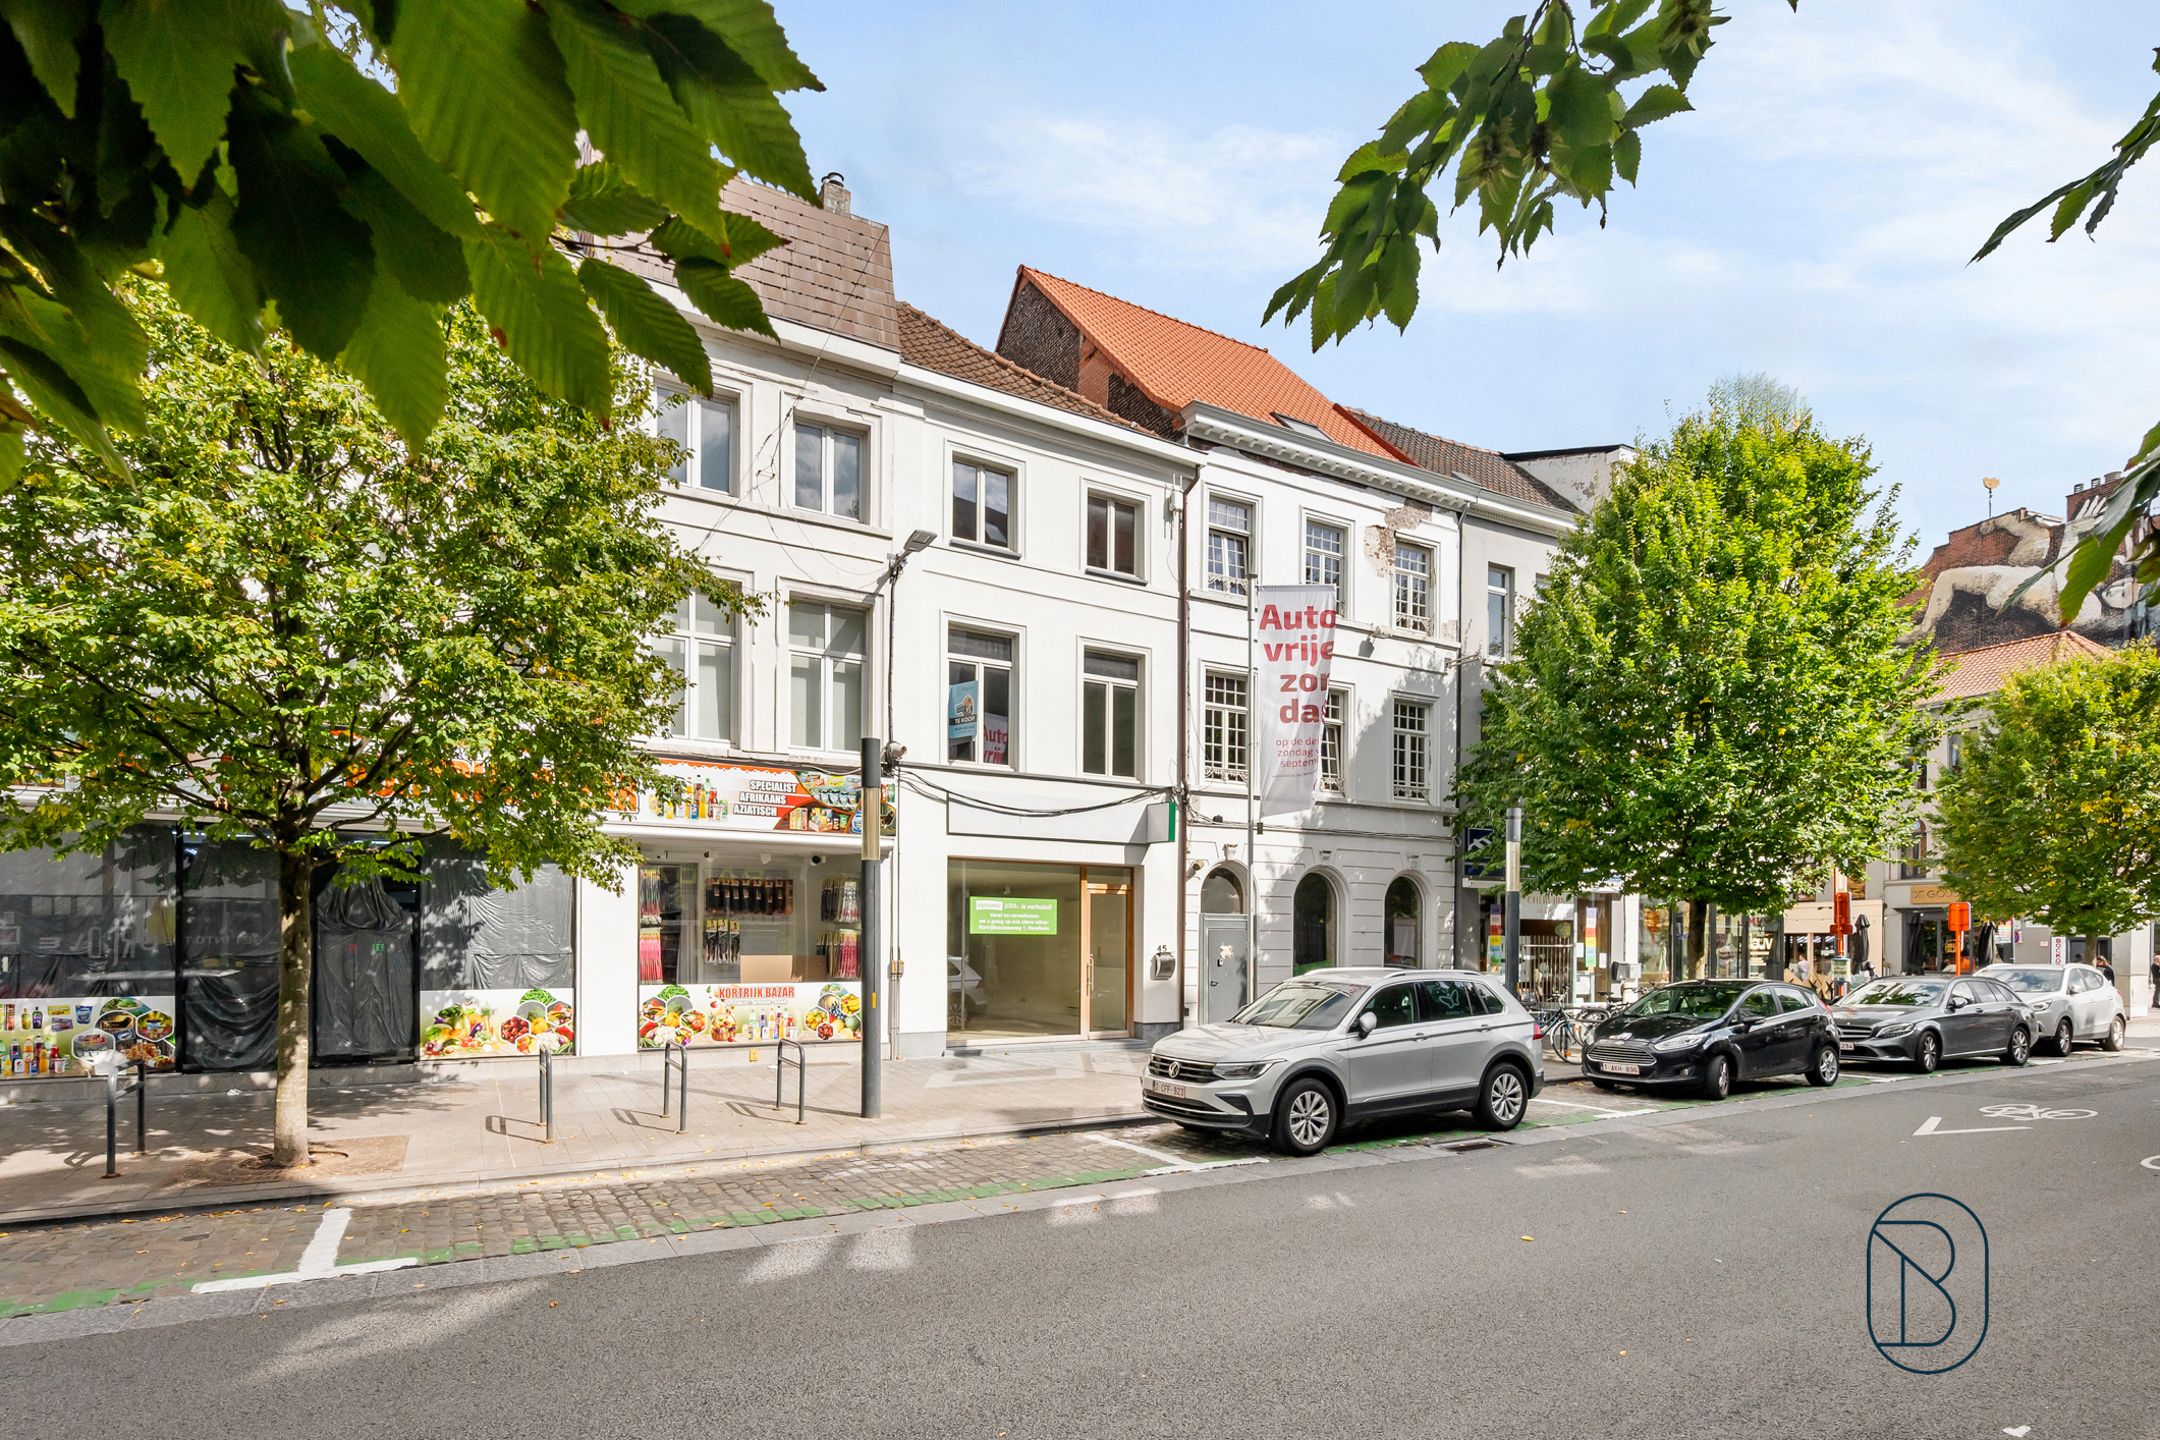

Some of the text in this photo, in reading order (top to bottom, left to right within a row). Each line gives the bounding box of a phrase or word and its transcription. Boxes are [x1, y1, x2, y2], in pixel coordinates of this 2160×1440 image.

[1259, 604, 1336, 630] Auto
[1263, 634, 1334, 667] vrije
[1275, 739, 1289, 748] op
[1291, 737, 1303, 746] de
[1277, 749, 1314, 758] zondag
[1280, 758, 1318, 769] septem
[750, 780, 797, 793] SPECIALIST
[739, 791, 787, 805] AFRIKAANS
[733, 804, 778, 817] AZIATISCH
[1157, 945, 1168, 953] 45
[719, 986, 795, 999] KORTRIJK BAZAR
